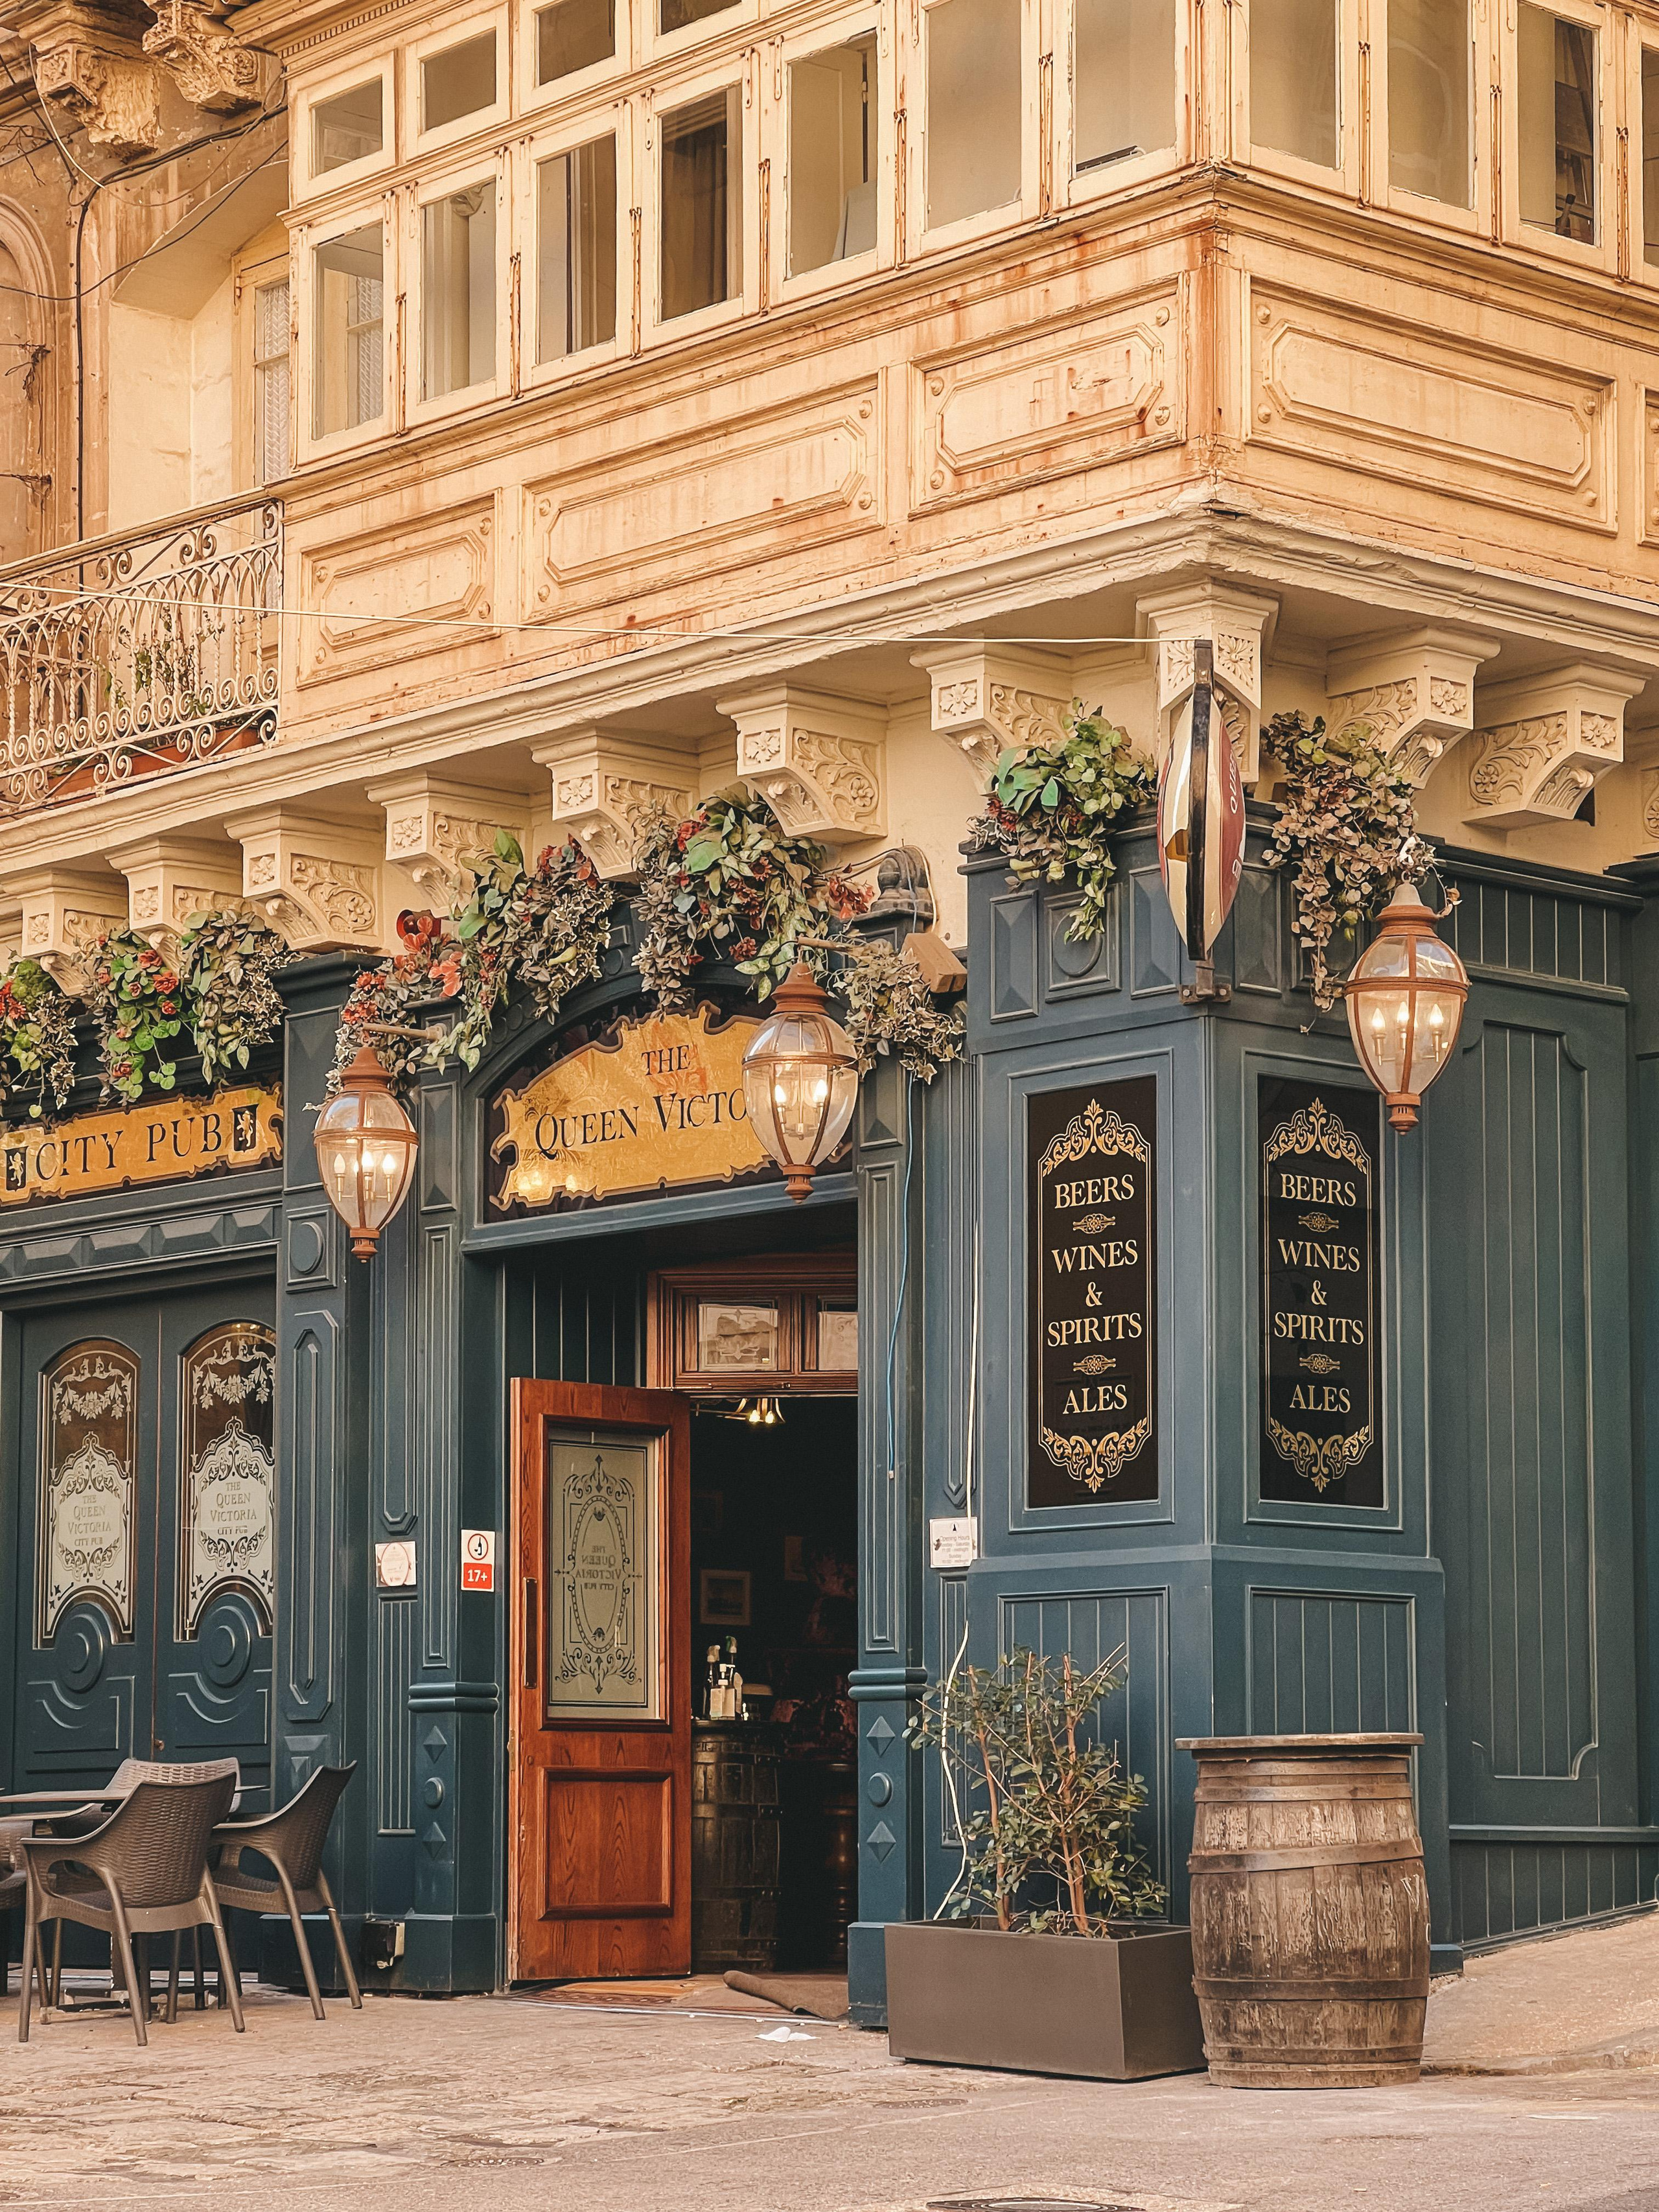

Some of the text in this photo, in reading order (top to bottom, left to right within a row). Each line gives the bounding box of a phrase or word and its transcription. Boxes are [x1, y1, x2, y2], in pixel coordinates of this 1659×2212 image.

[641, 1045, 690, 1076] THE
[535, 1088, 747, 1160] QUEEN VICTO
[36, 1113, 222, 1180] CITY PUB
[1054, 1174, 1135, 1209] BEERS
[1280, 1173, 1356, 1207] BEERS
[1051, 1239, 1138, 1274] WINES
[1277, 1239, 1360, 1272] WINES
[1085, 1281, 1103, 1307] &
[1311, 1280, 1327, 1305] &
[1047, 1312, 1142, 1347] SPIRITS
[1274, 1312, 1364, 1345] SPIRITS
[1062, 1384, 1128, 1414] ALES
[1289, 1384, 1351, 1414] ALES
[82, 1495, 97, 1504] THE
[216, 1493, 251, 1508] QUEEN
[226, 1482, 240, 1491] THE
[67, 1520, 111, 1535] VICTORIA
[73, 1505, 106, 1520] QUEEN
[210, 1509, 257, 1522] VICTORIA
[467, 1569, 487, 1582] 17+
